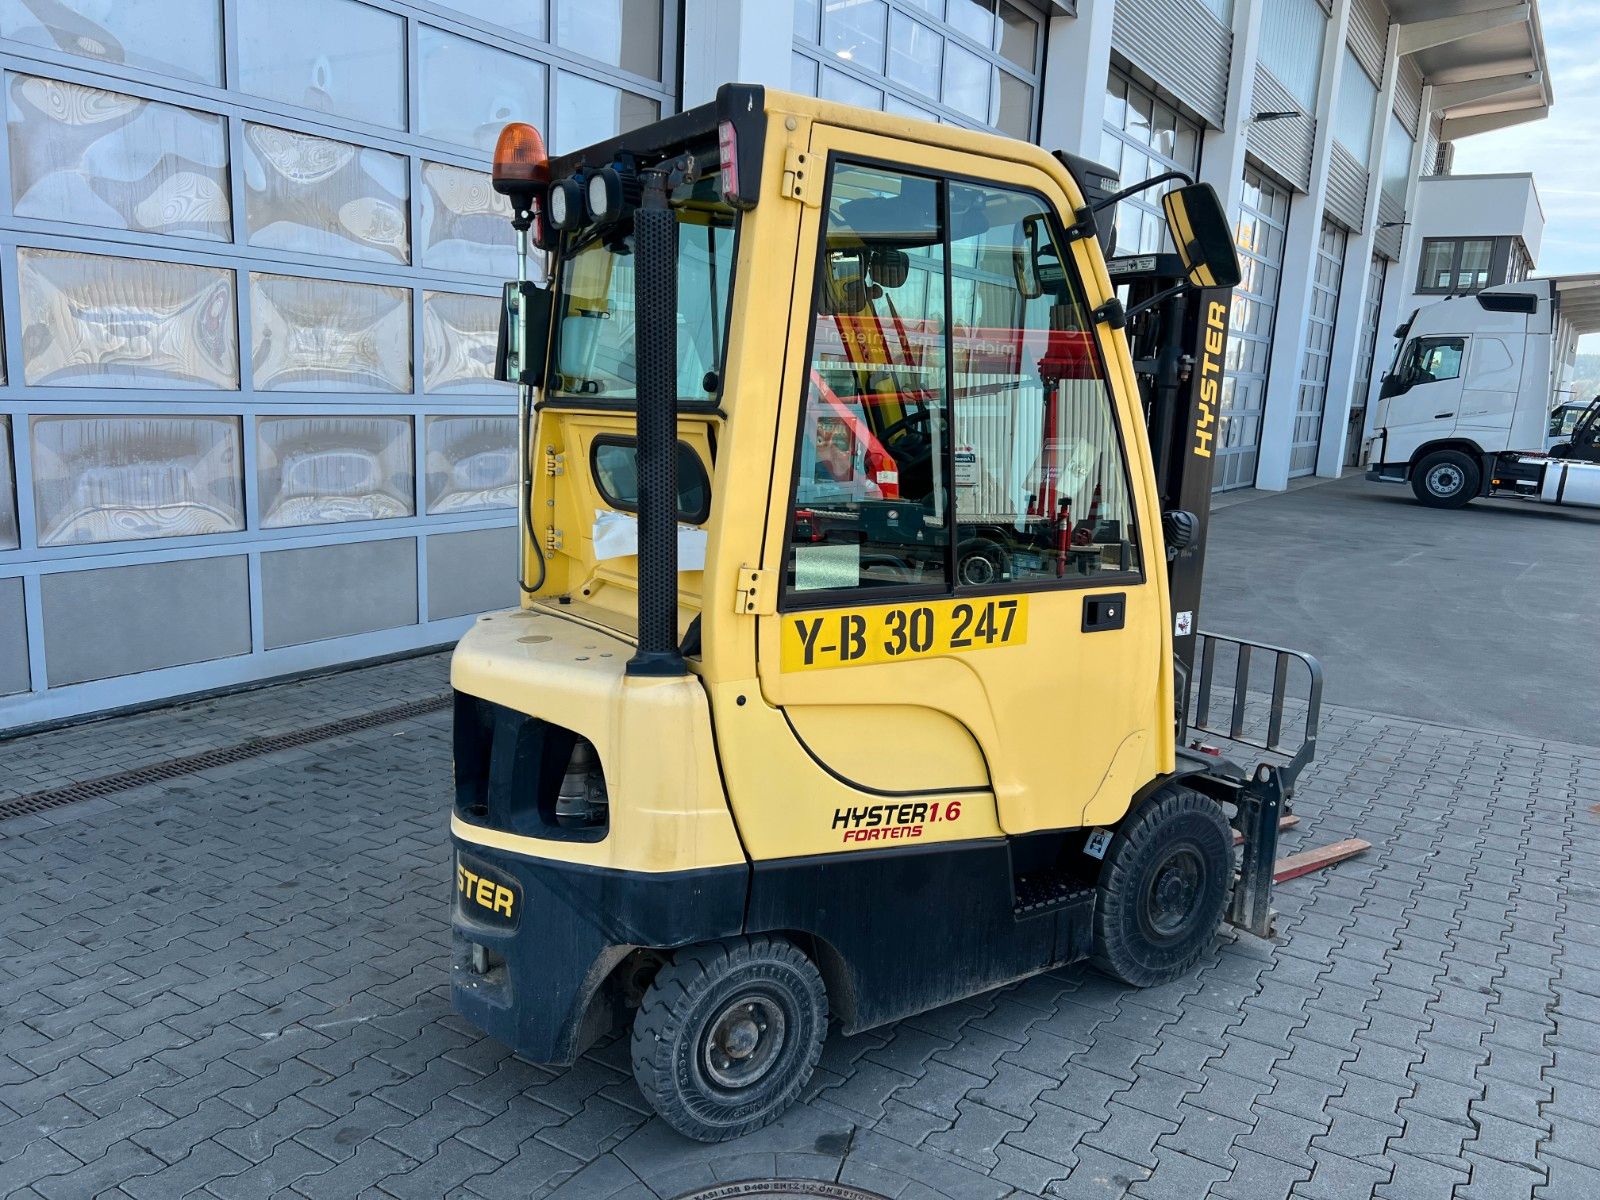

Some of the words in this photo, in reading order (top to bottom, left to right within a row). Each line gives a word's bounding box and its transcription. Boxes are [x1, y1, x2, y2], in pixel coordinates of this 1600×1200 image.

[1194, 301, 1226, 457] HYSTER
[794, 615, 867, 665] Y-B
[884, 607, 934, 656] 30
[950, 600, 1018, 648] 247
[832, 803, 928, 829] HYSTER
[929, 801, 962, 823] 1.6
[843, 825, 923, 843] FORTENS
[457, 864, 514, 918] STER
